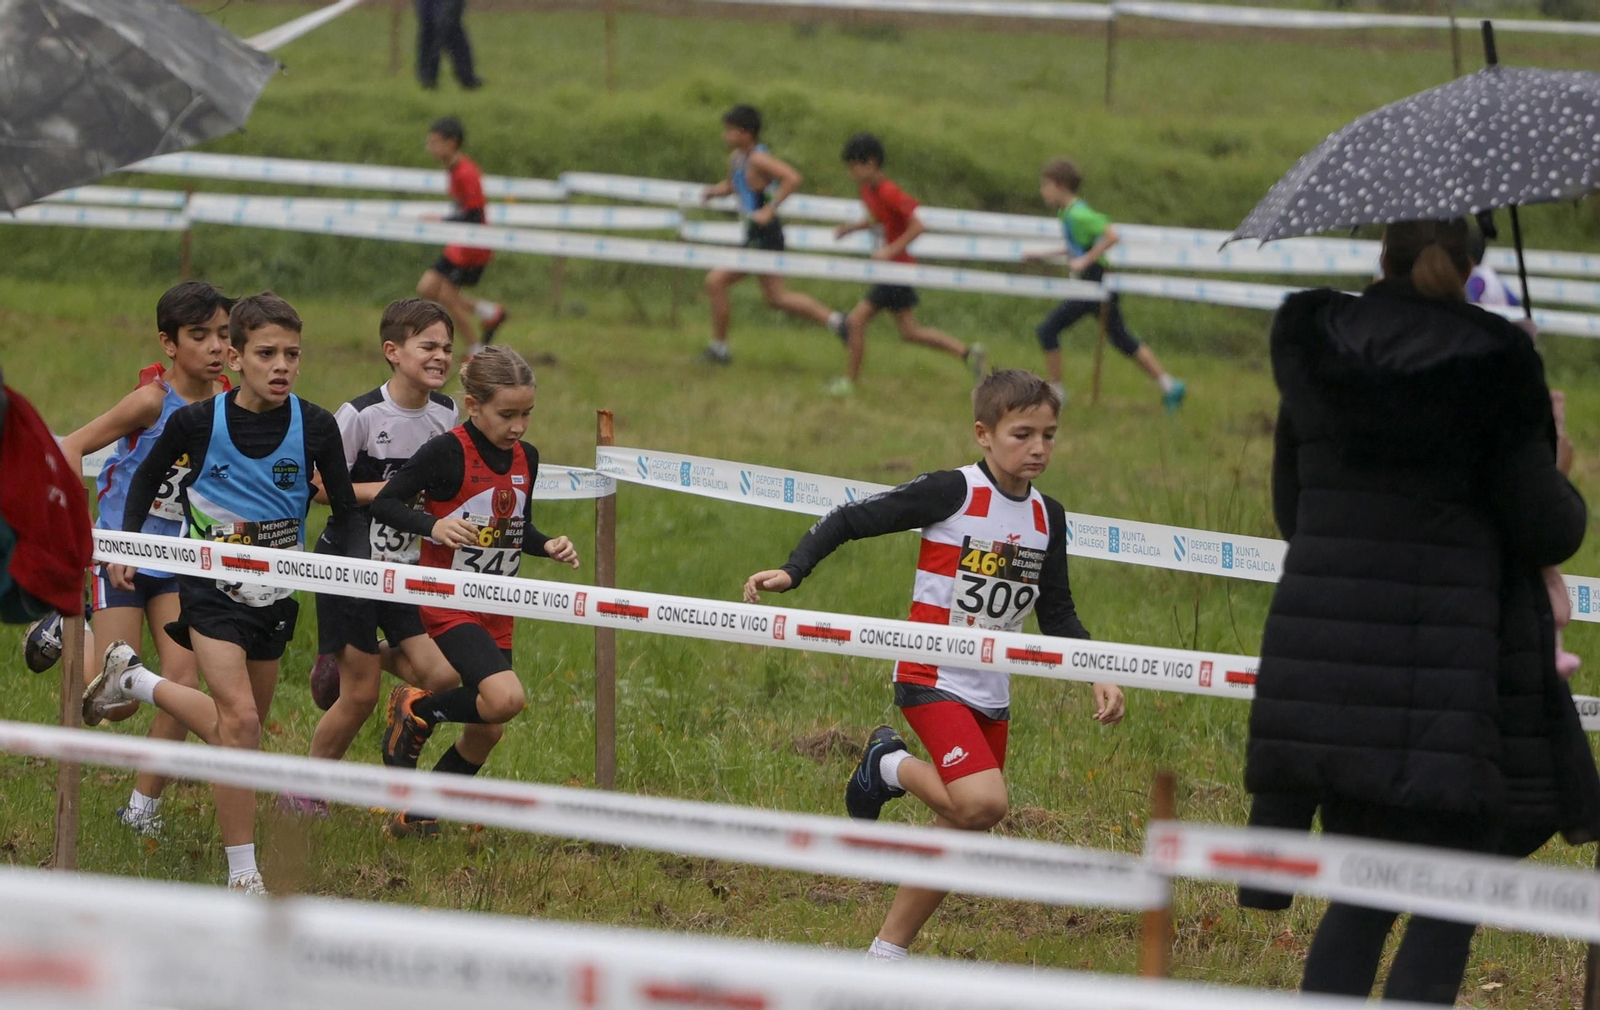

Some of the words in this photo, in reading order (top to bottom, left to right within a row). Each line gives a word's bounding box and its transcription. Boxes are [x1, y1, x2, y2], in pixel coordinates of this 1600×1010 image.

[651, 459, 679, 471] DEPORTE
[691, 465, 714, 477] XUNTA
[584, 478, 611, 489] GALEGO
[652, 471, 678, 483] GALEGO
[691, 475, 701, 486] DE
[702, 477, 729, 491] GALICIA
[756, 474, 783, 487] DEPORTE
[755, 488, 780, 499] GALEGO
[796, 480, 820, 494] XUNTA
[795, 492, 805, 503] DE
[805, 494, 833, 507] GALICIA
[257, 526, 299, 540] BELARMINO
[1078, 524, 1107, 536] DEPORTE
[1121, 530, 1146, 543] XUNTA
[270, 534, 297, 547] ALONSO
[1078, 537, 1104, 549] GALEGO
[1190, 539, 1220, 551] DEPORTE
[98, 538, 152, 557] CONCELLO
[154, 545, 169, 560] DE
[172, 547, 197, 563] VIGO
[1121, 543, 1131, 553] DE
[1132, 544, 1161, 557] GALICIA
[1235, 545, 1260, 558] XUNTA
[456, 546, 522, 577] 342
[1191, 553, 1218, 565] GALEGO
[1235, 559, 1245, 568] DE
[1246, 560, 1276, 572] GALICIA
[276, 559, 332, 580] CONCELLO
[335, 567, 349, 583] DE
[353, 568, 379, 586] VIGO
[462, 582, 521, 603] CONCELLO
[524, 590, 539, 605] DE
[543, 592, 569, 609] VIGO
[956, 574, 1034, 620] 309
[656, 605, 718, 626] CONCELLO
[720, 613, 737, 629] DE
[740, 615, 768, 632] VIGO
[859, 628, 922, 650] CONCELLO
[926, 636, 942, 652] DE
[946, 637, 976, 656] VIGO
[1071, 651, 1138, 673] CONCELLO
[1141, 659, 1158, 676] DE
[1162, 660, 1193, 679] VIGO
